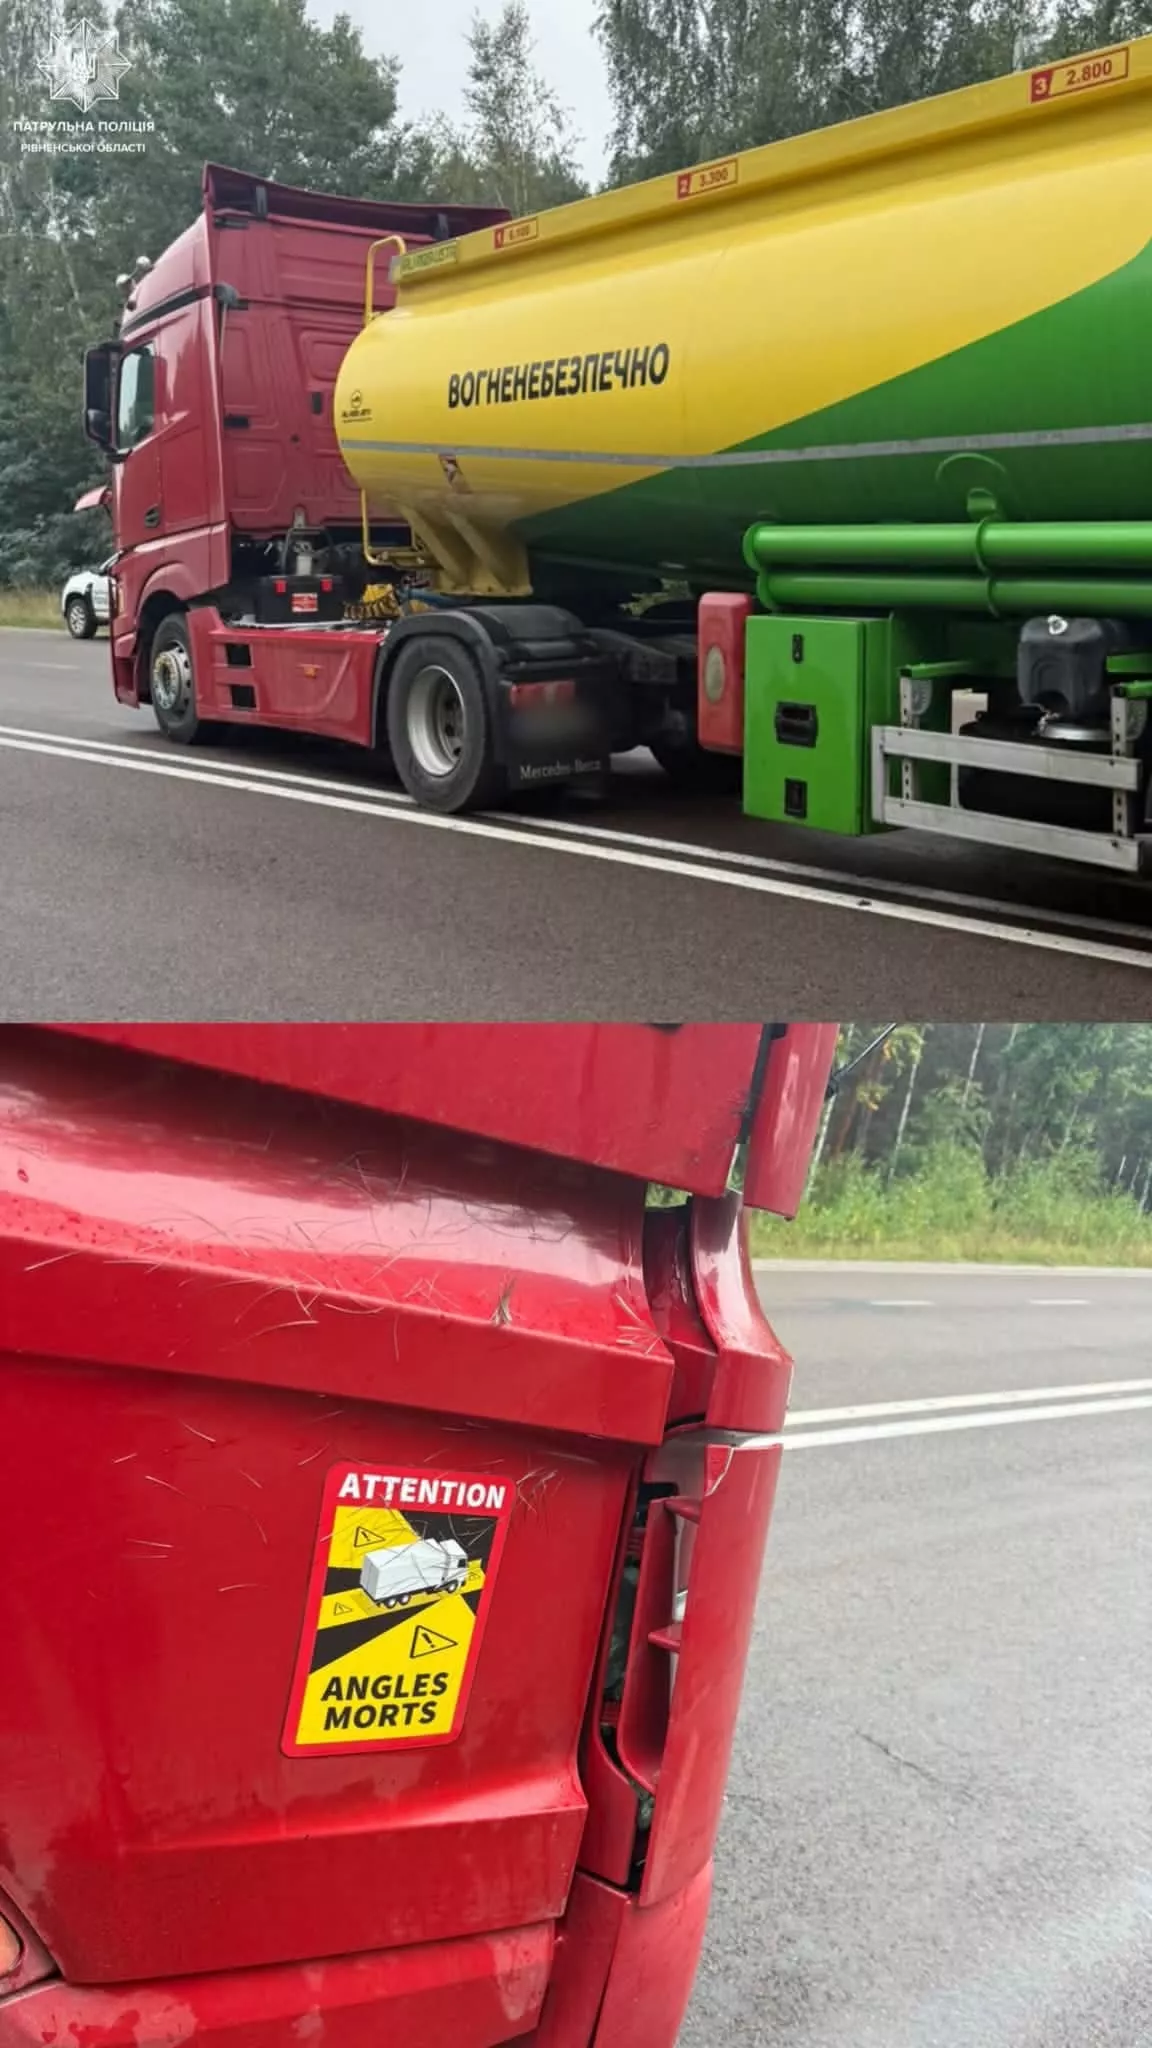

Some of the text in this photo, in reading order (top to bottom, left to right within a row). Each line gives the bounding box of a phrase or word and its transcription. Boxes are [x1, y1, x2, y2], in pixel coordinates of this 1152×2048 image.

[1035, 60, 1112, 96] 3 2.800
[448, 343, 670, 408] ВОГНЕНЕБЕЗПЕЧНО
[338, 1472, 506, 1509] ATTENTION
[320, 1672, 449, 1702] ANGLES
[323, 1701, 438, 1731] MORTS
